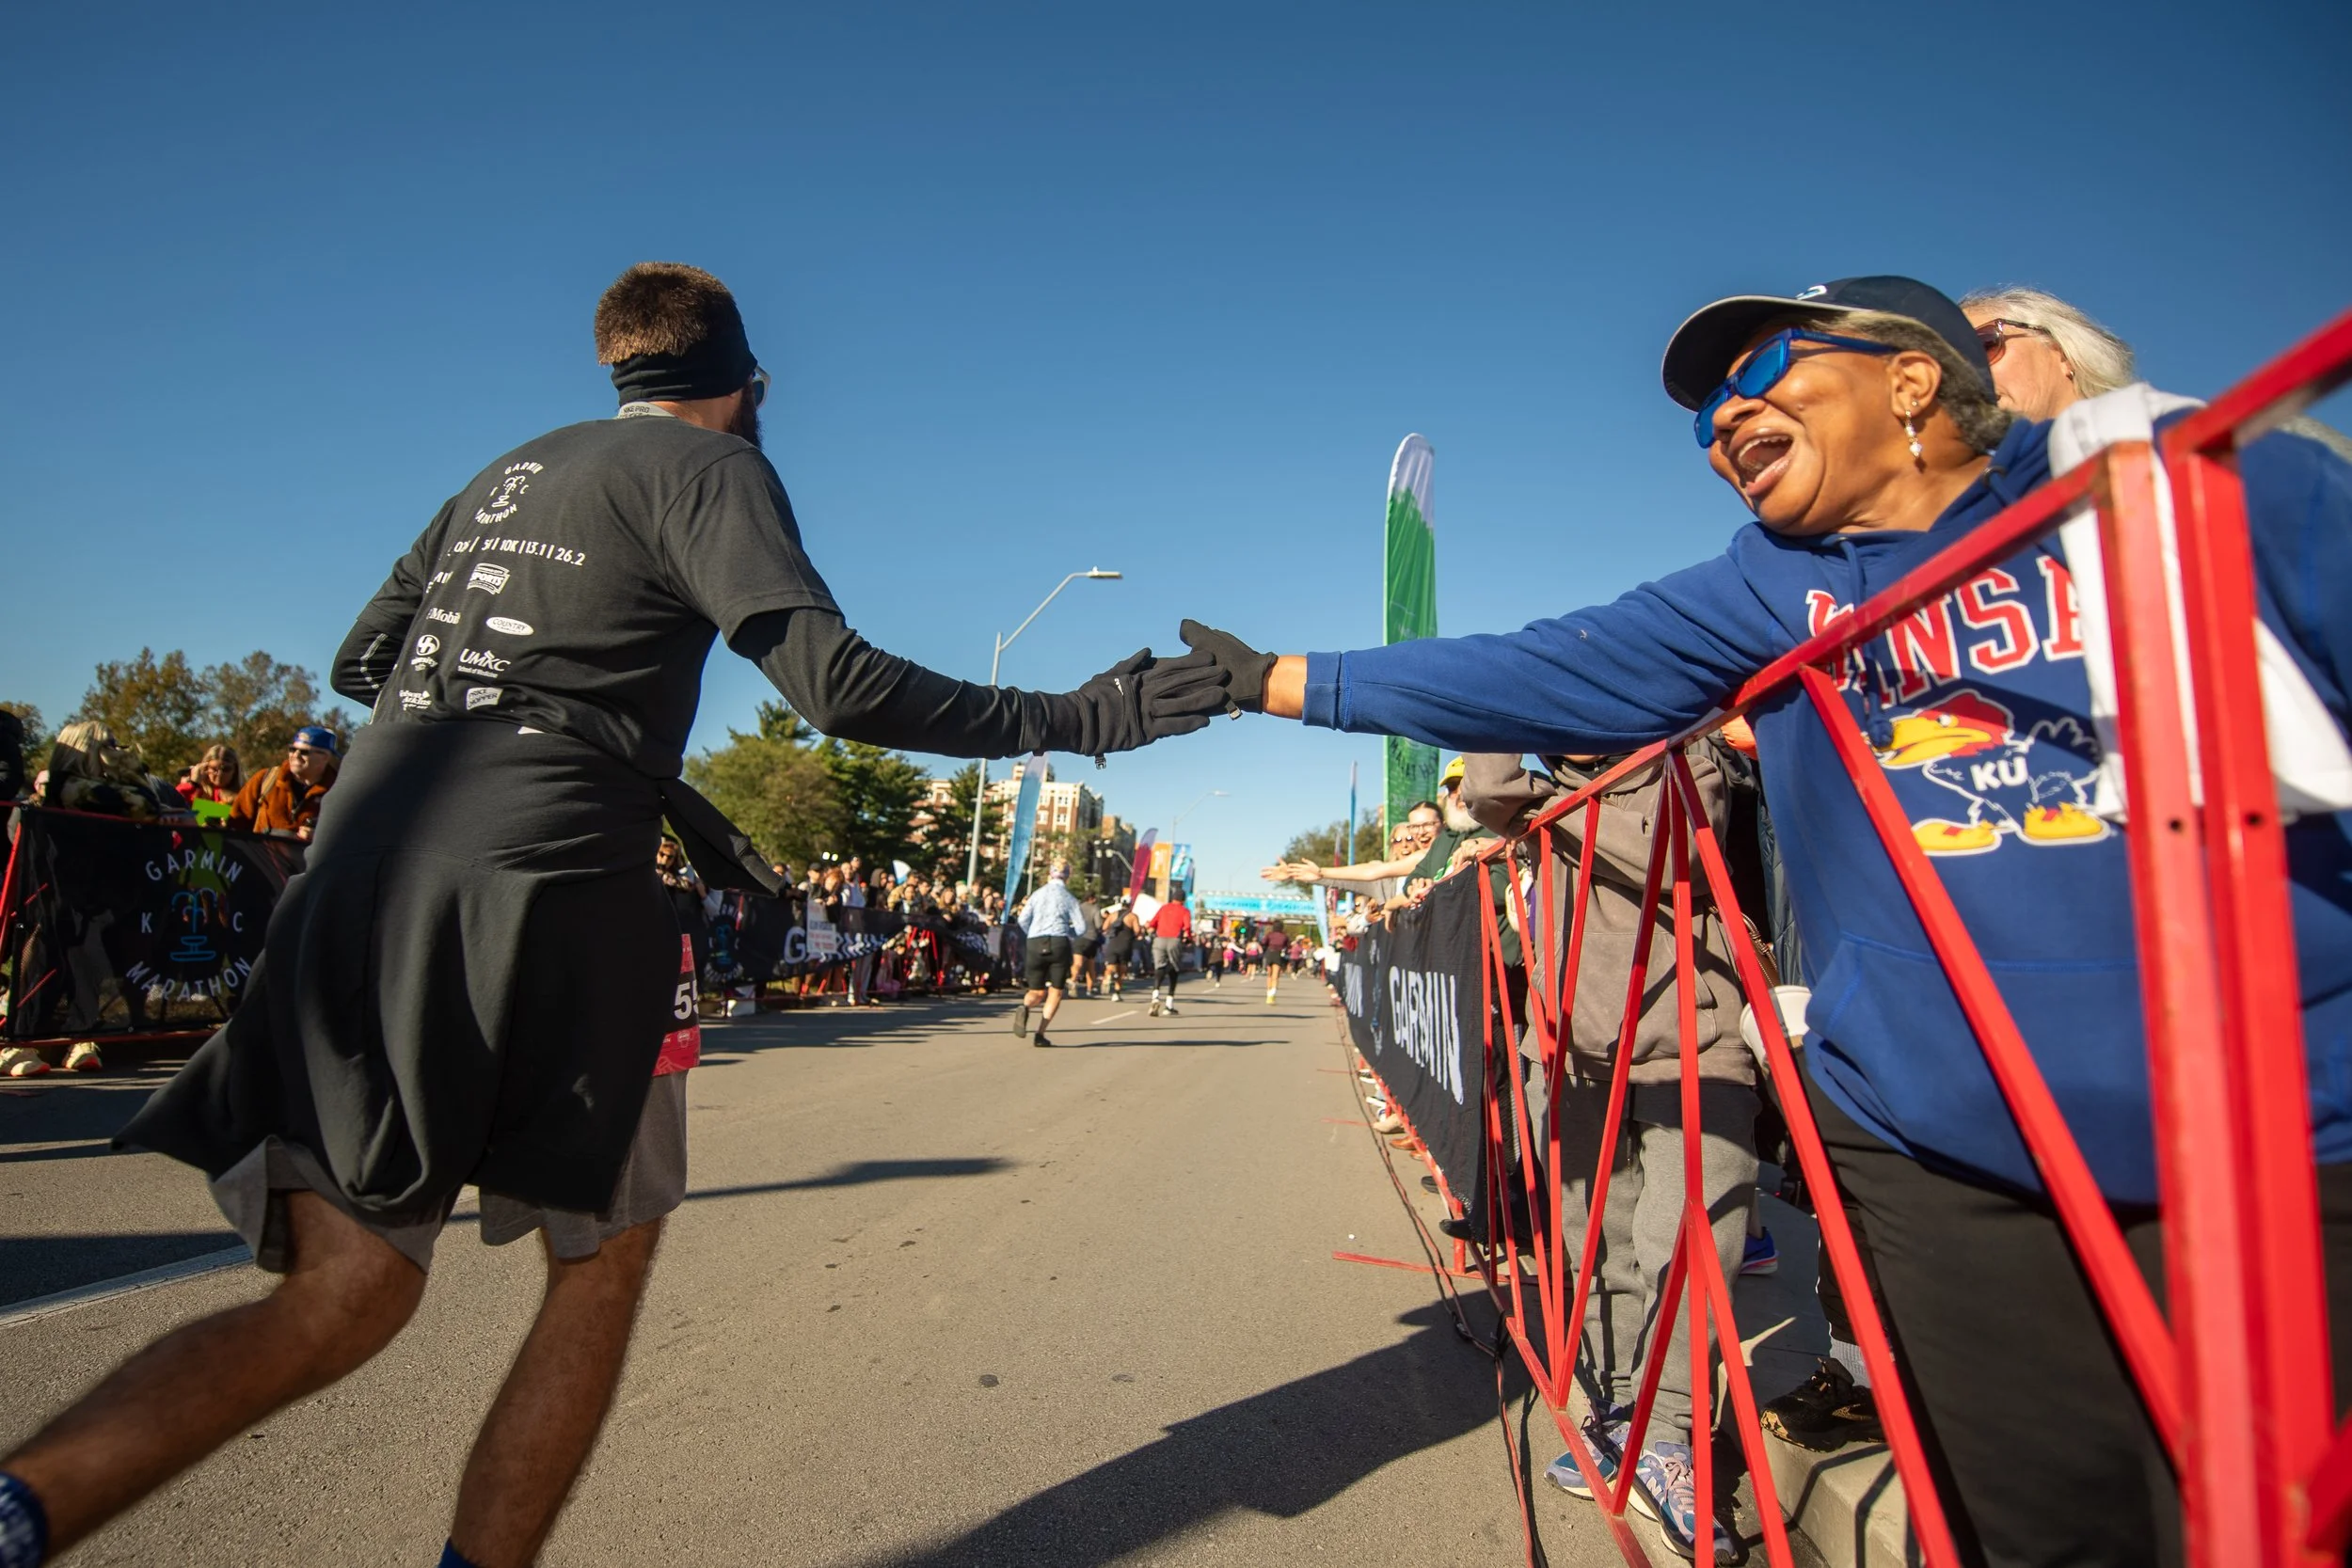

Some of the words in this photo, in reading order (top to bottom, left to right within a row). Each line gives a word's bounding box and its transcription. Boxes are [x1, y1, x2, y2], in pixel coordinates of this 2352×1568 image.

[635, 405, 650, 414] PRO
[500, 539, 519, 552] 10K
[525, 541, 547, 557] 13.1
[554, 547, 586, 566] 26.2
[460, 648, 511, 672] UMKC
[1970, 756, 2028, 792] KU
[145, 848, 244, 882] GARMIN
[141, 911, 152, 934] K
[232, 911, 244, 932] C
[126, 957, 252, 1003] MARATHON
[1389, 965, 1464, 1105] GARMIN
